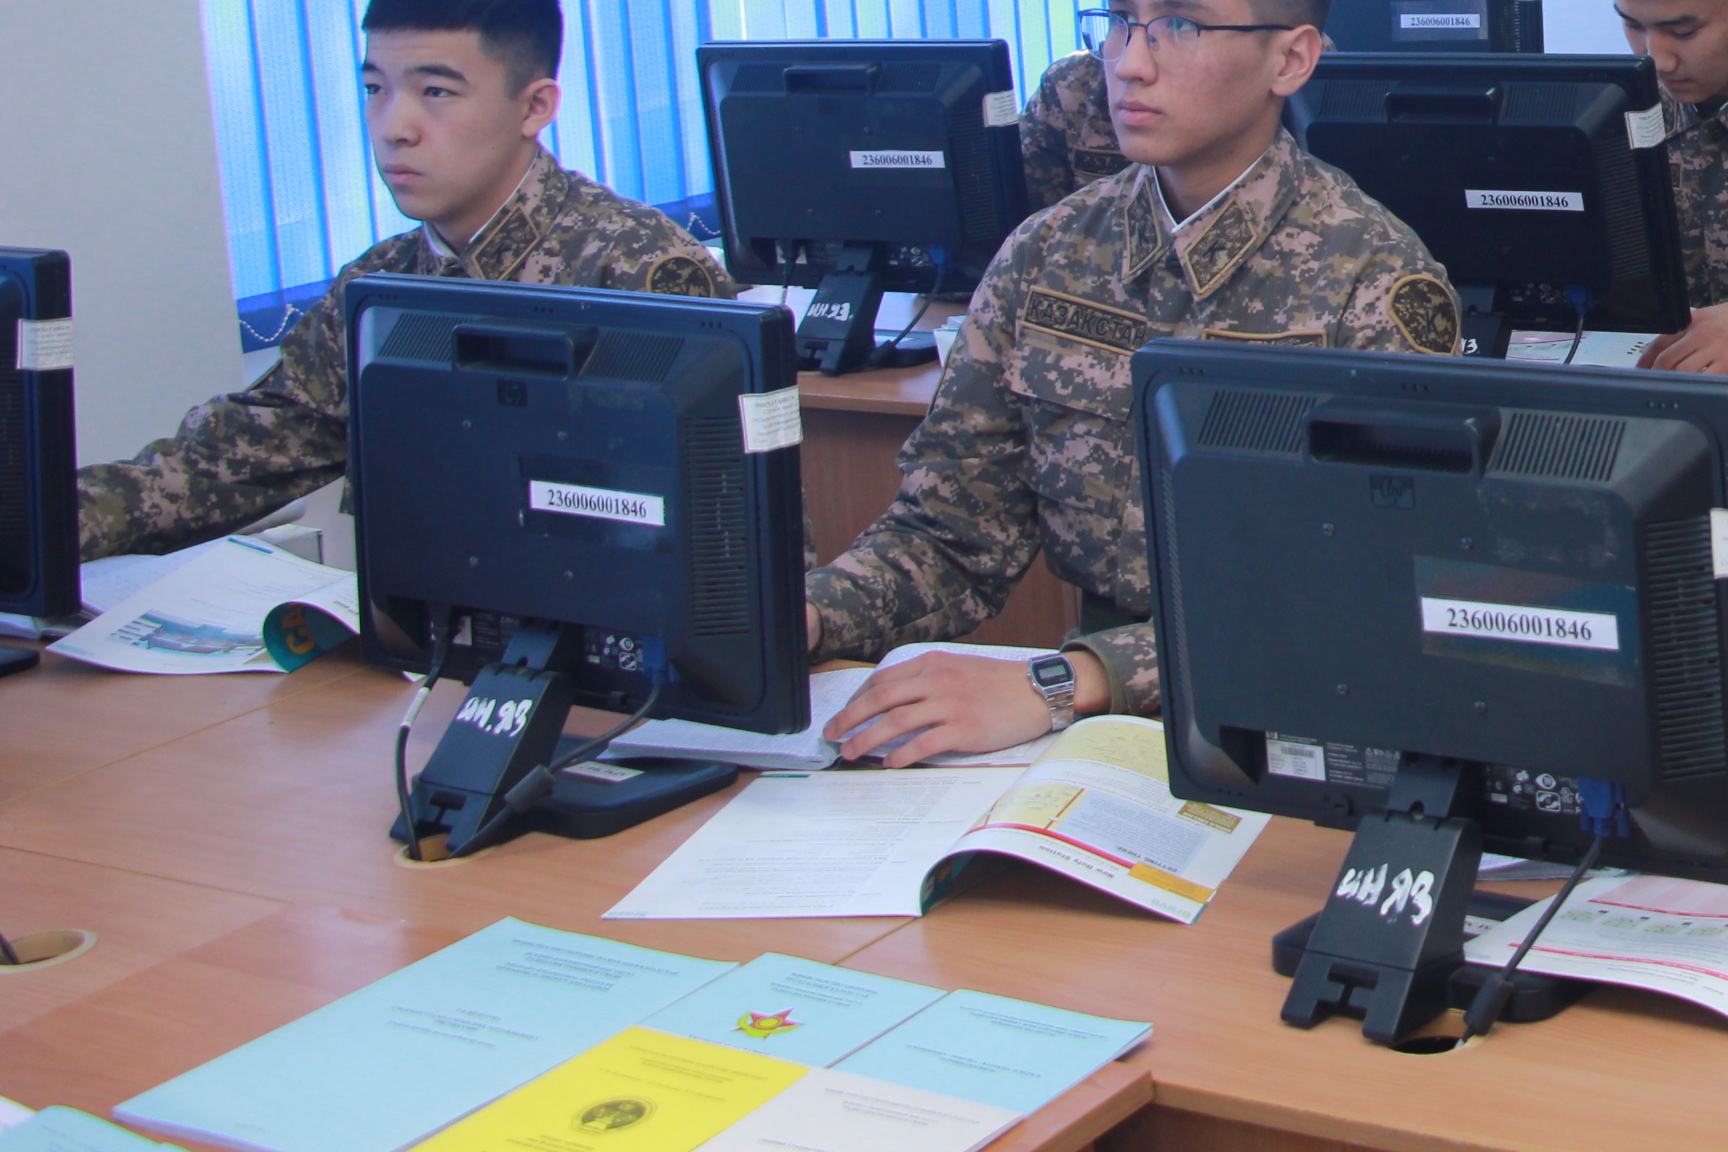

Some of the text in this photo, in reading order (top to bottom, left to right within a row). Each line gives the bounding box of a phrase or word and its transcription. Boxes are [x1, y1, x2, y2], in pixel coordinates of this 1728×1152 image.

[1410, 16, 1471, 27] 236006001846
[862, 154, 933, 166] 236006001846
[1480, 193, 1569, 209] 236006001846
[546, 488, 648, 519] 236006001846
[1446, 606, 1594, 642] 236006001846
[1039, 844, 1072, 861] Station
[1073, 857, 1094, 870] Duty
